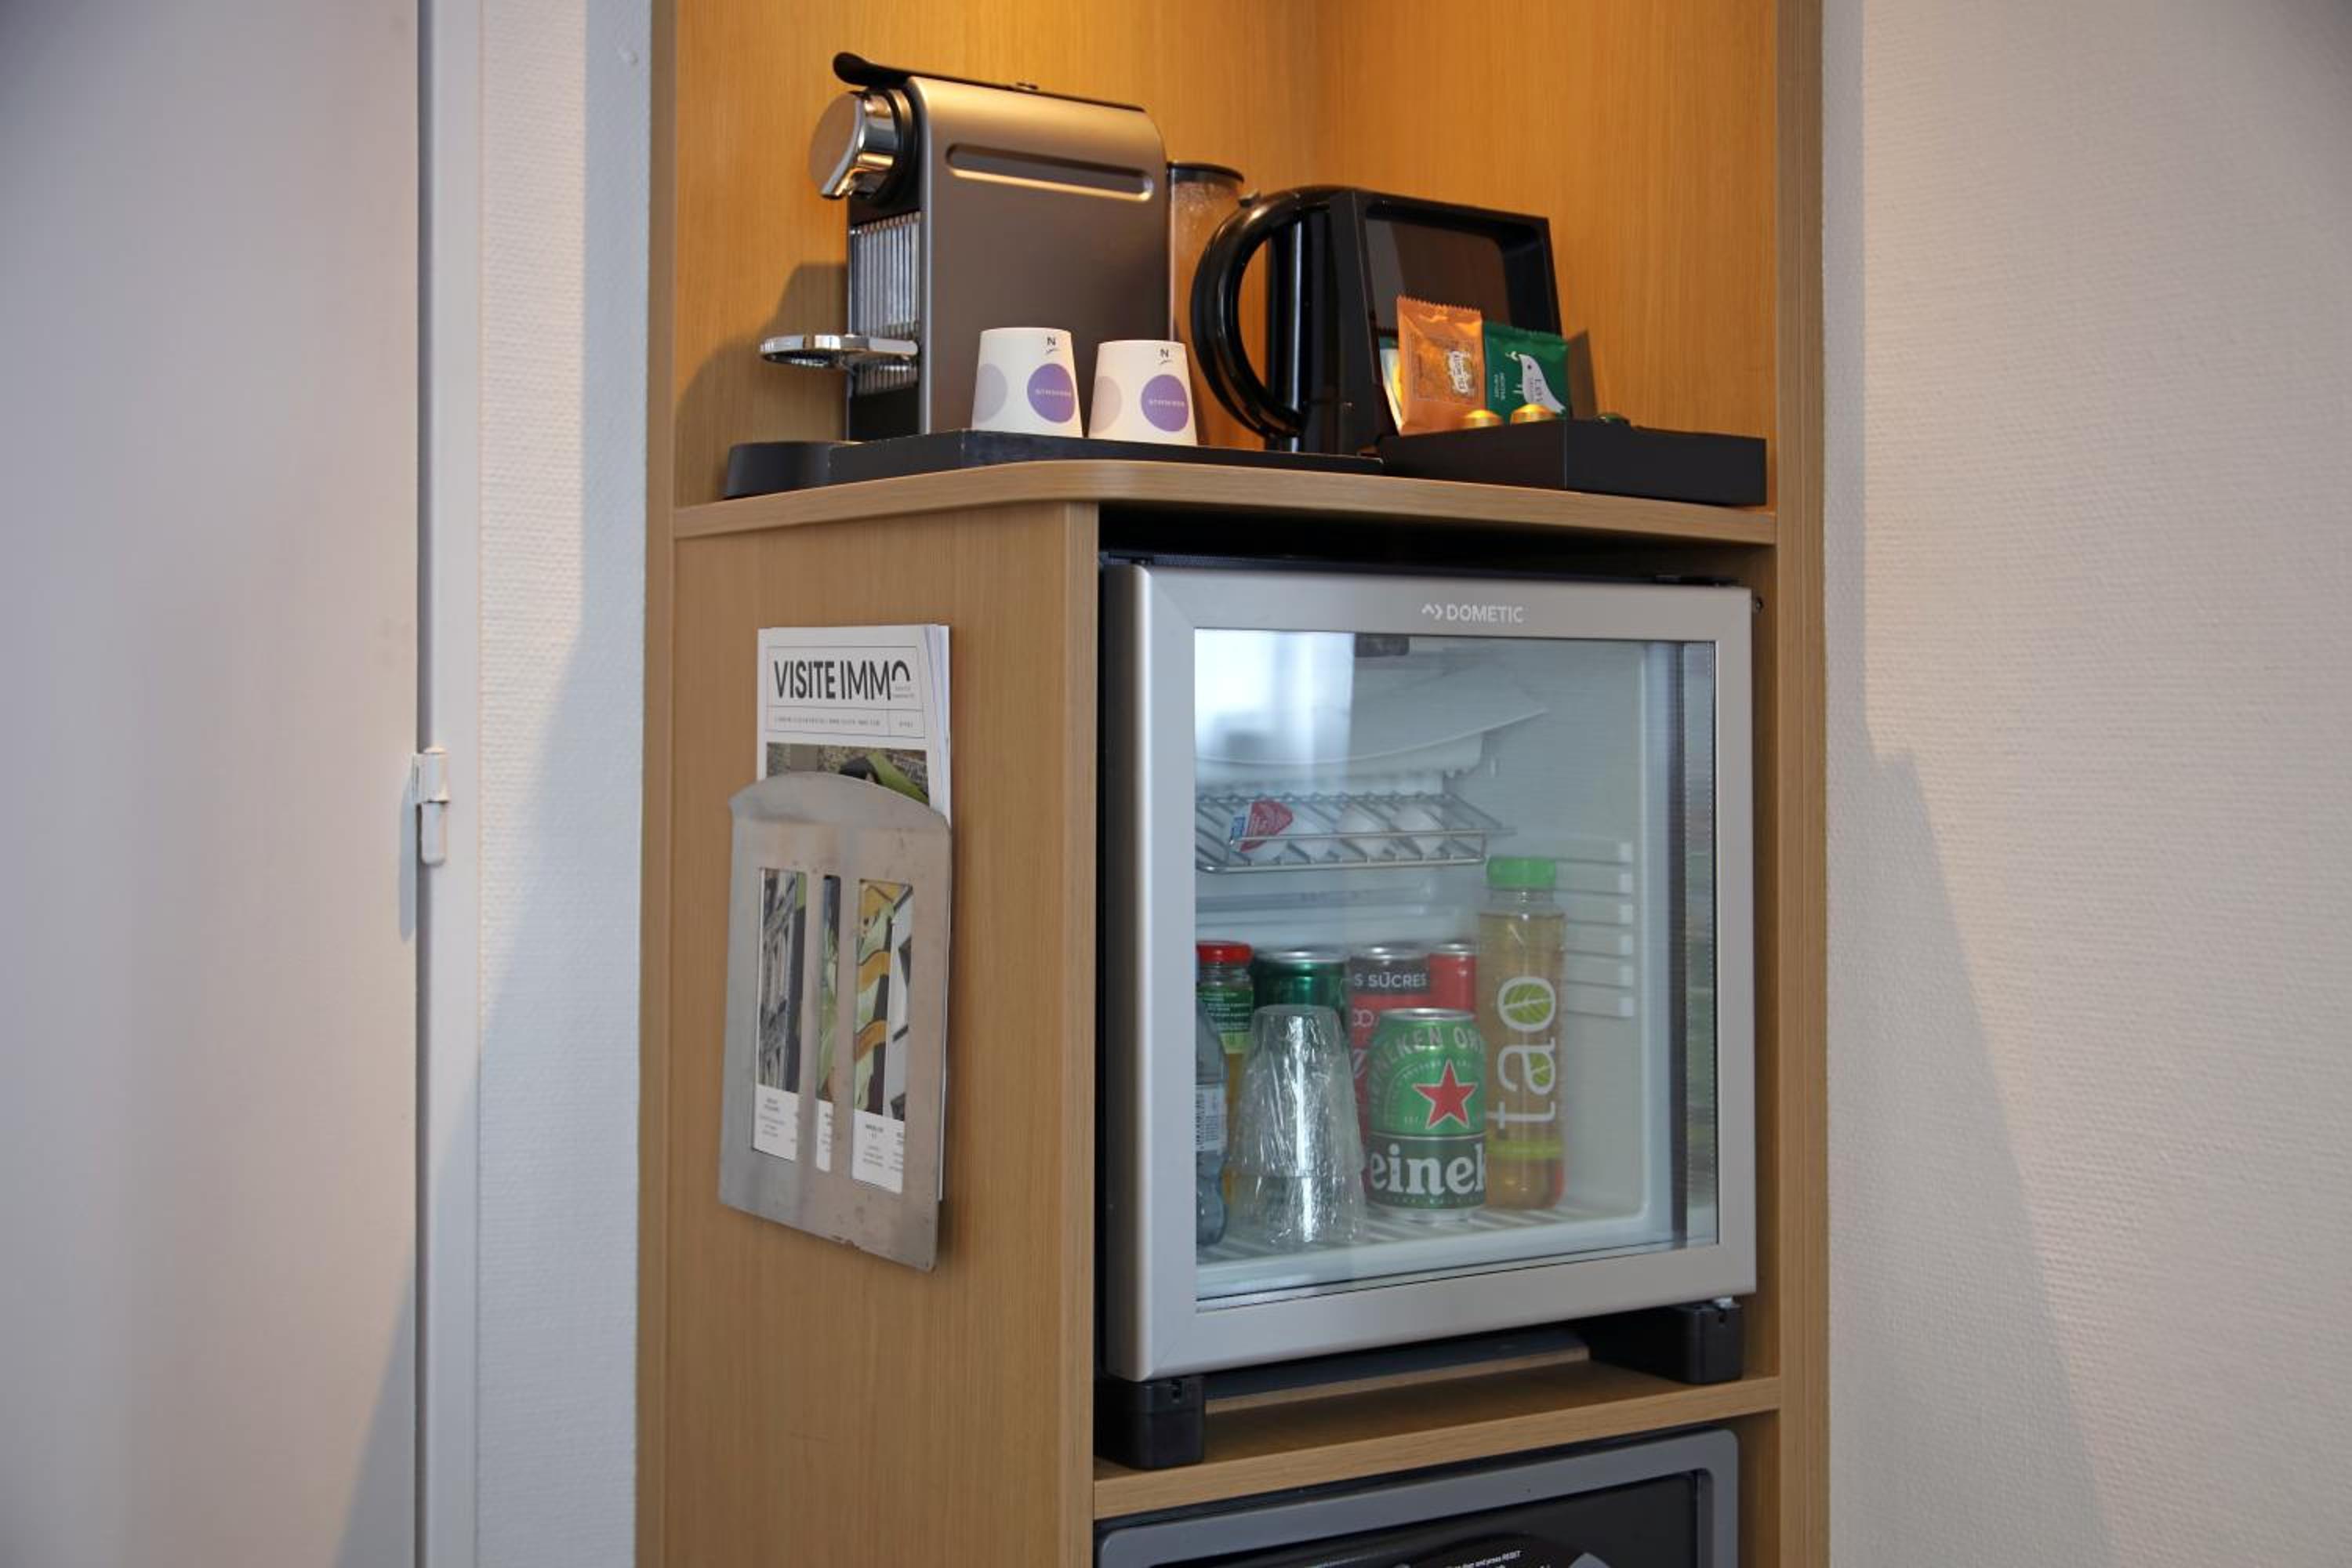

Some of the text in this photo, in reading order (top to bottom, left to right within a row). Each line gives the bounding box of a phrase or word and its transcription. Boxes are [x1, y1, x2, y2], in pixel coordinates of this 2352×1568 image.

[1446, 603, 1524, 624] DOMETIC
[774, 660, 837, 699] VISITE
[1486, 977, 1556, 1127] tao
